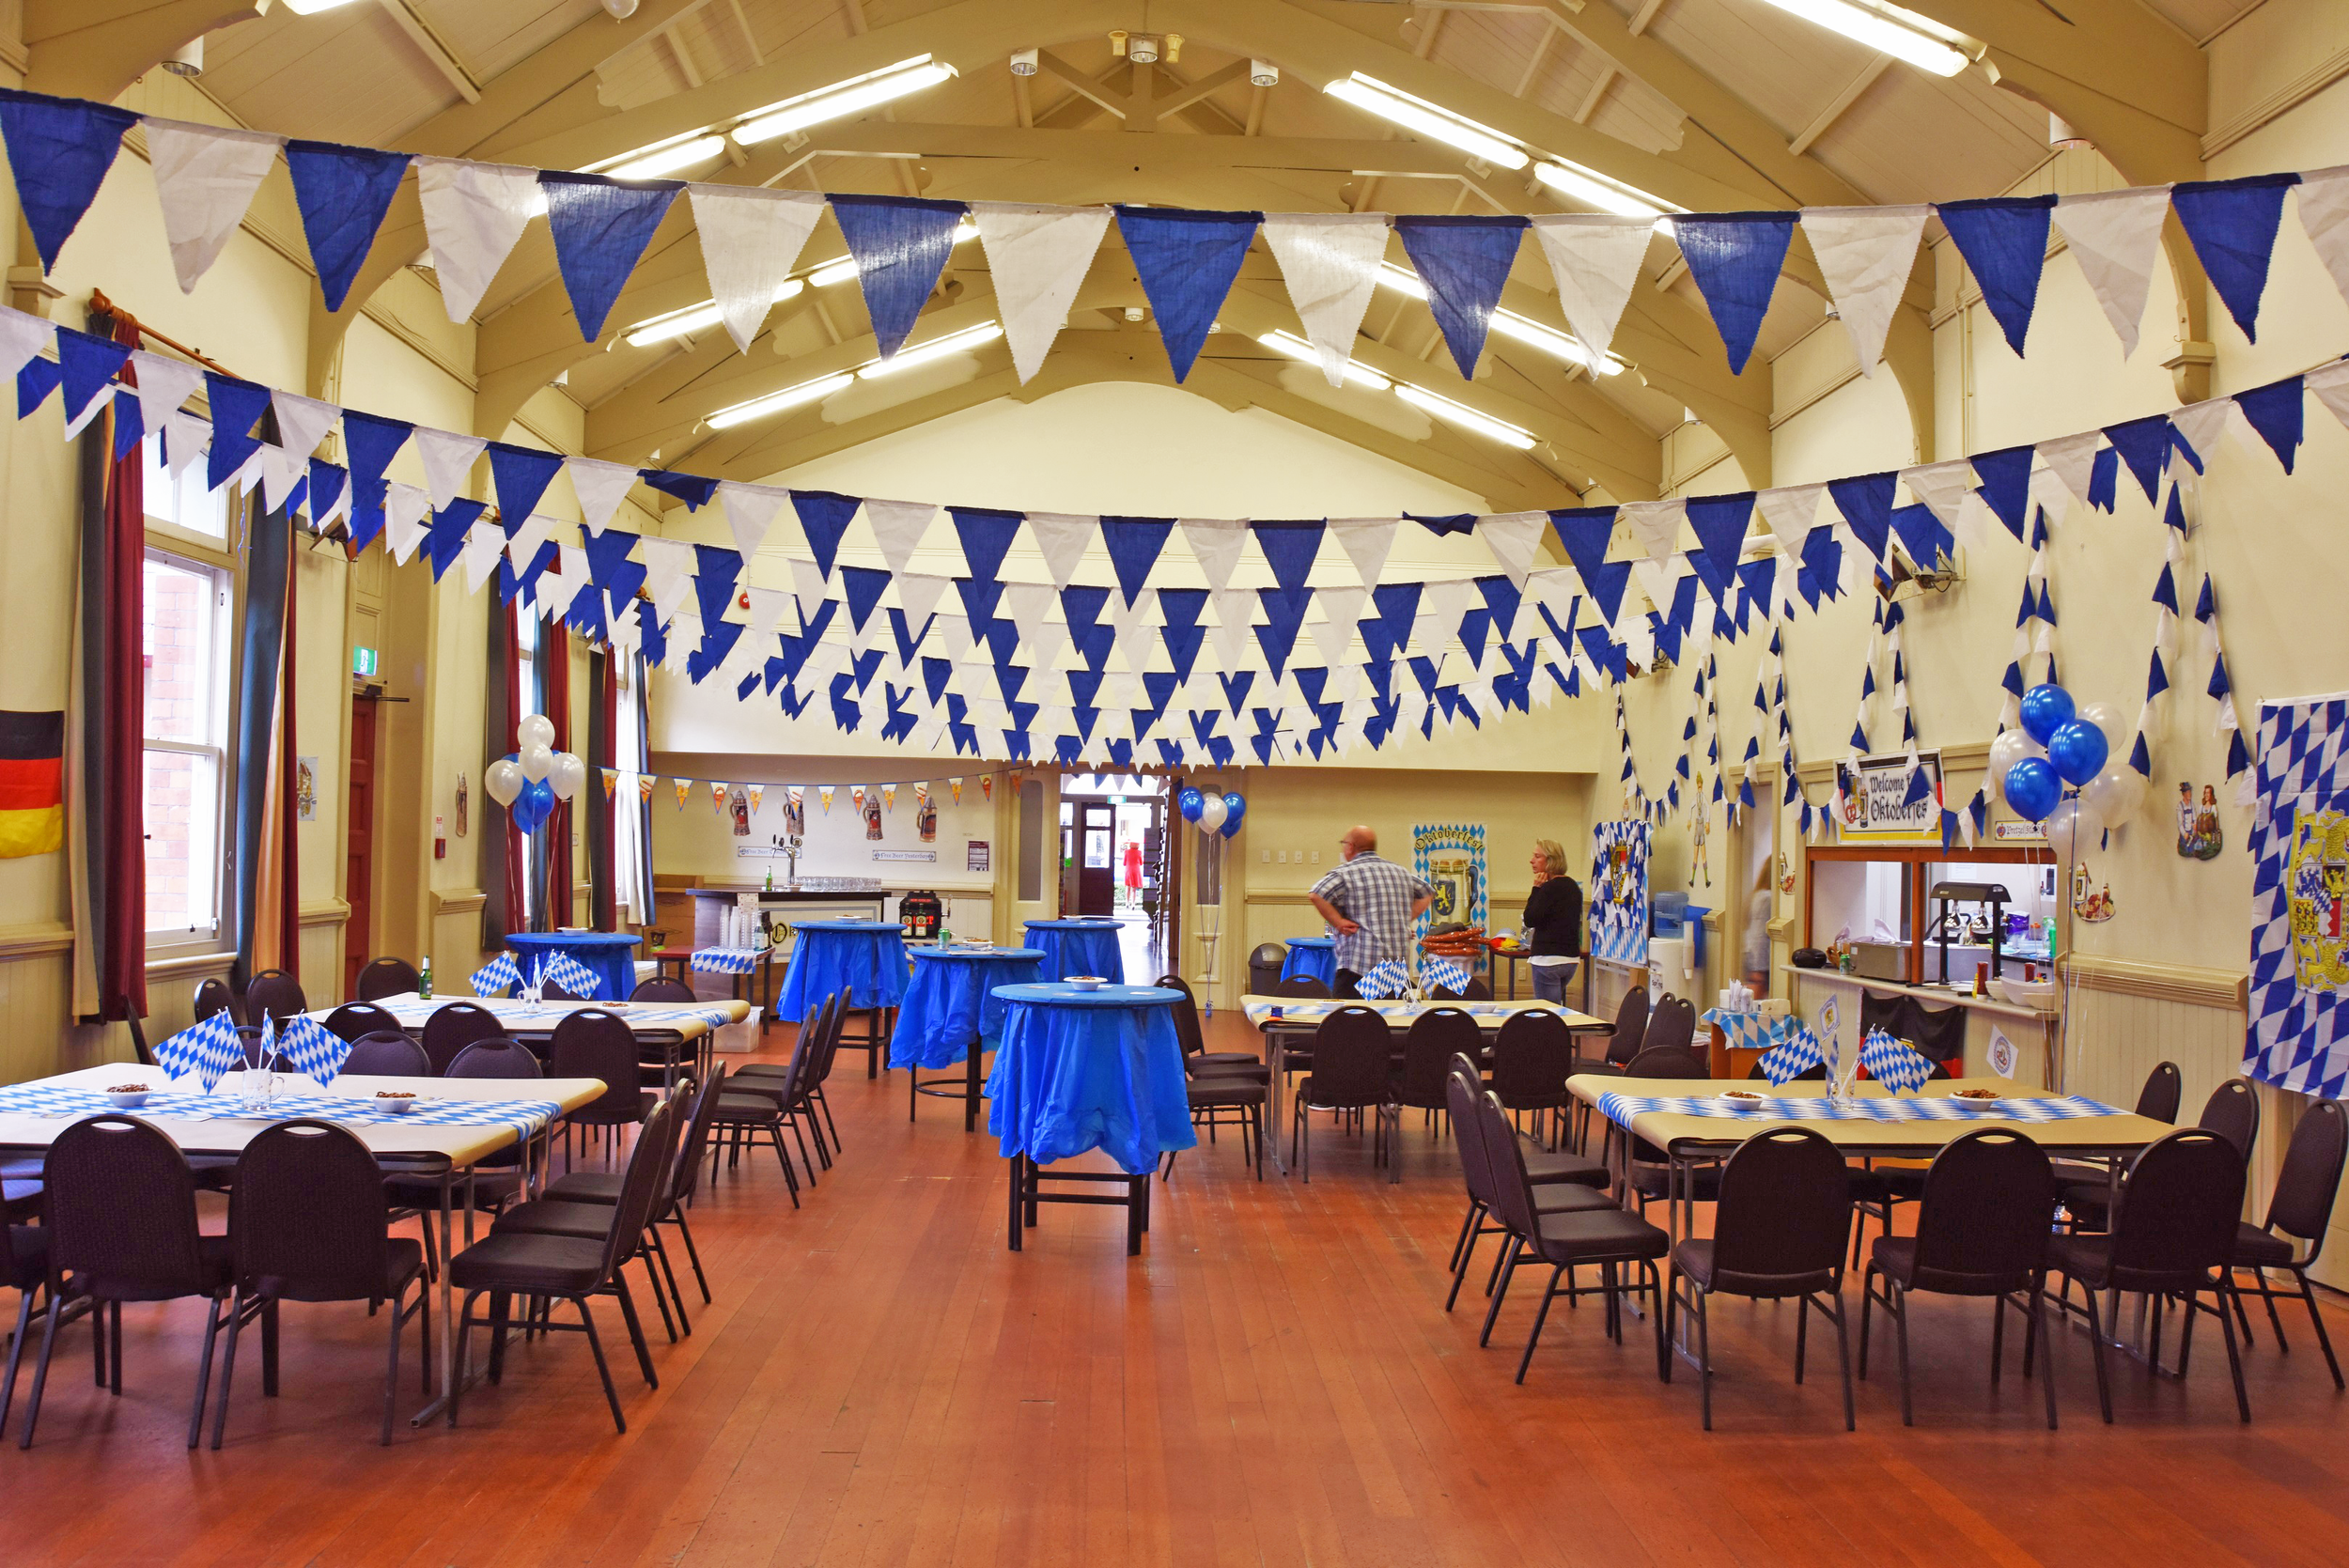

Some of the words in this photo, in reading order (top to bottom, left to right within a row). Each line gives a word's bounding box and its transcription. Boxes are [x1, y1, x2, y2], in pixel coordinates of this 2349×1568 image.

[1869, 771, 1905, 793] Welcome
[1870, 794, 1928, 826] Oktoberfes
[1414, 828, 1484, 850] Oktoberfest
